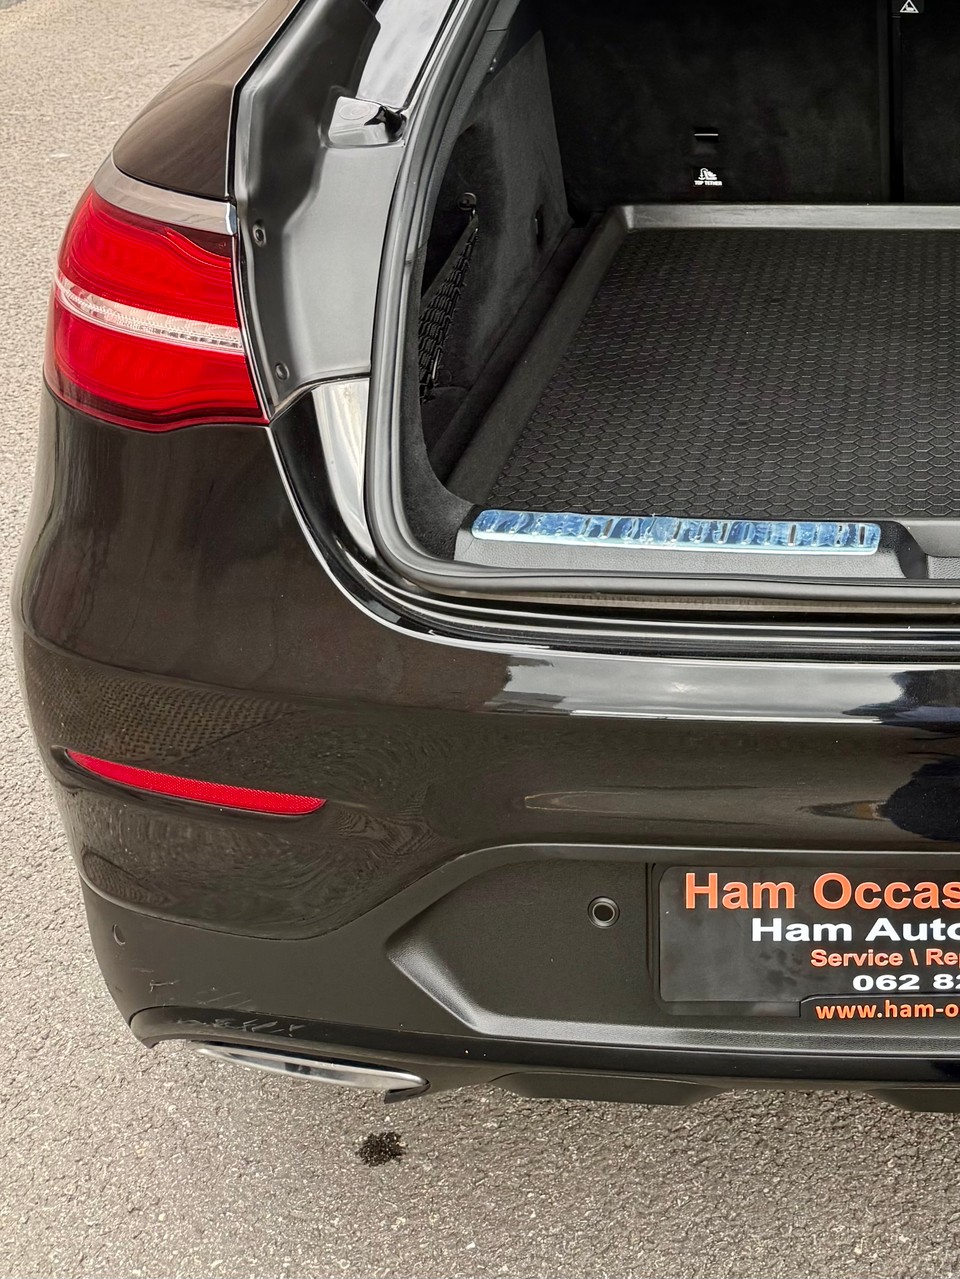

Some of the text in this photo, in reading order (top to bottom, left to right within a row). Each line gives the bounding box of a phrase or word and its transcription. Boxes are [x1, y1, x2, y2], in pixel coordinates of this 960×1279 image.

[686, 873, 796, 910] Ham
[751, 918, 853, 942] Ham
[811, 949, 903, 967] Service
[853, 974, 920, 991] 062
